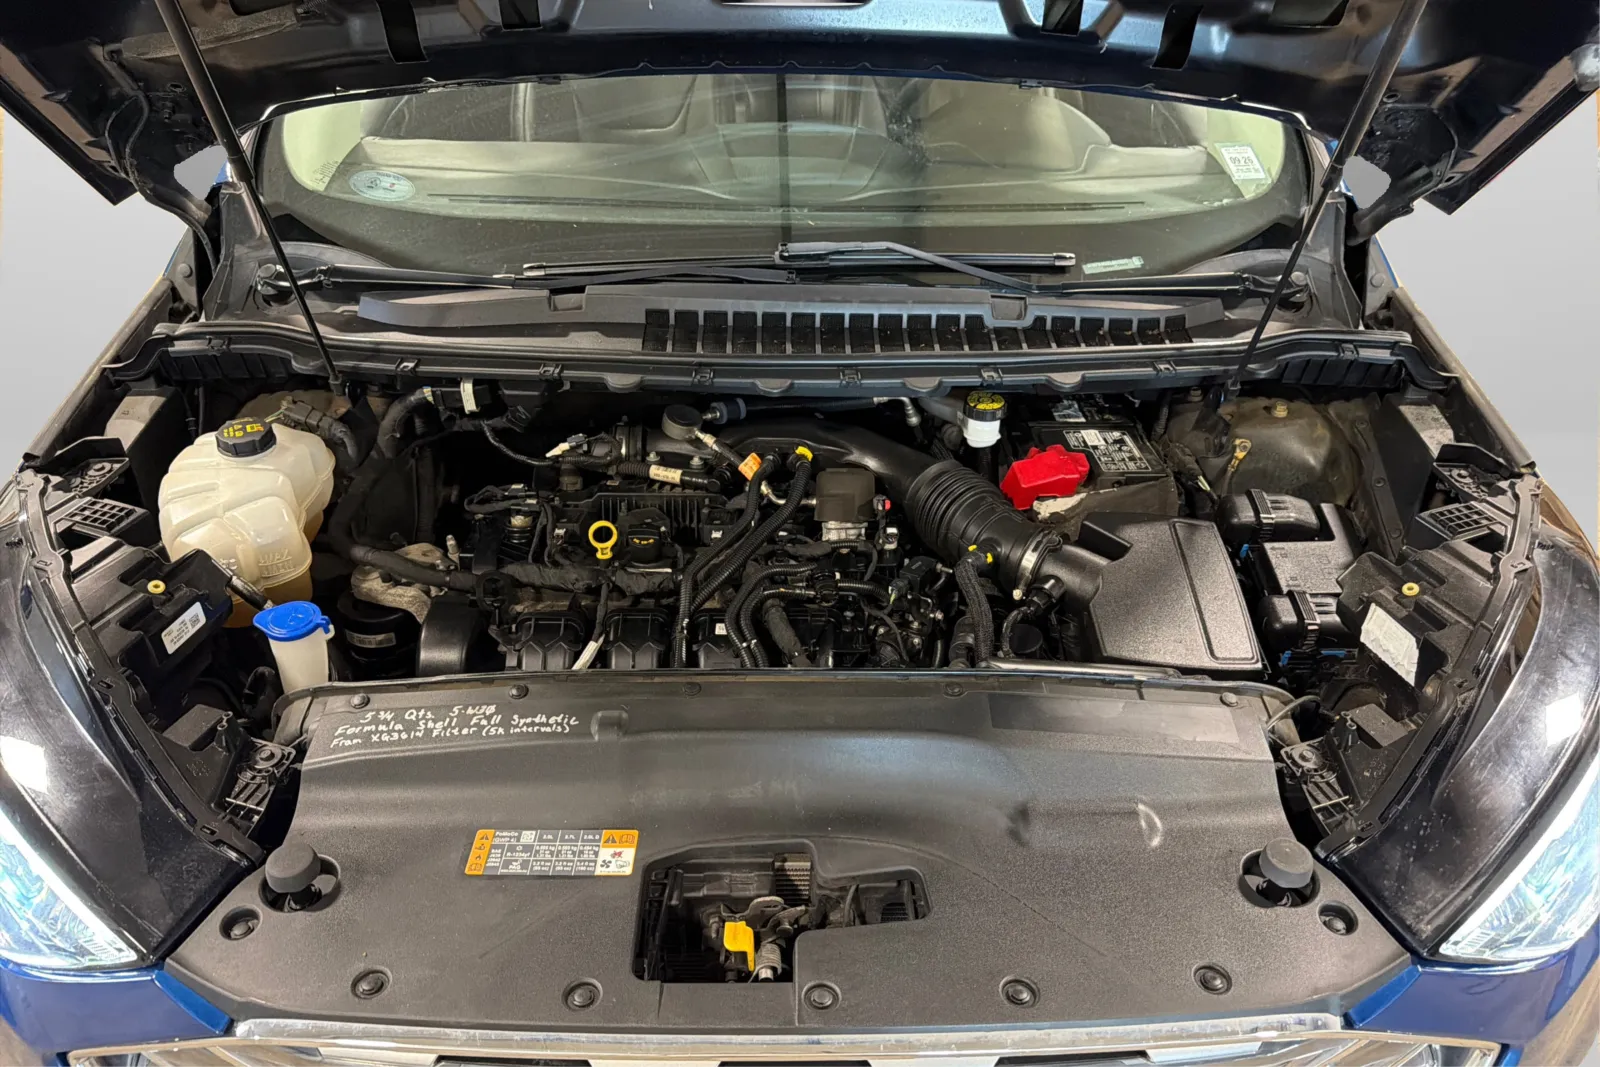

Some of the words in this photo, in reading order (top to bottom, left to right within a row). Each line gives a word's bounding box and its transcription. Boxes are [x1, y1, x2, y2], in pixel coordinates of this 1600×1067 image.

[1229, 156, 1241, 164] 09
[334, 721, 404, 736] Formula
[416, 718, 457, 730] Shell
[510, 713, 579, 727] Synthetic
[360, 711, 376, 723] 5
[404, 708, 435, 720] Qts.
[330, 737, 362, 749] Fram
[432, 727, 478, 738] Filter
[510, 723, 570, 733] intervals)
